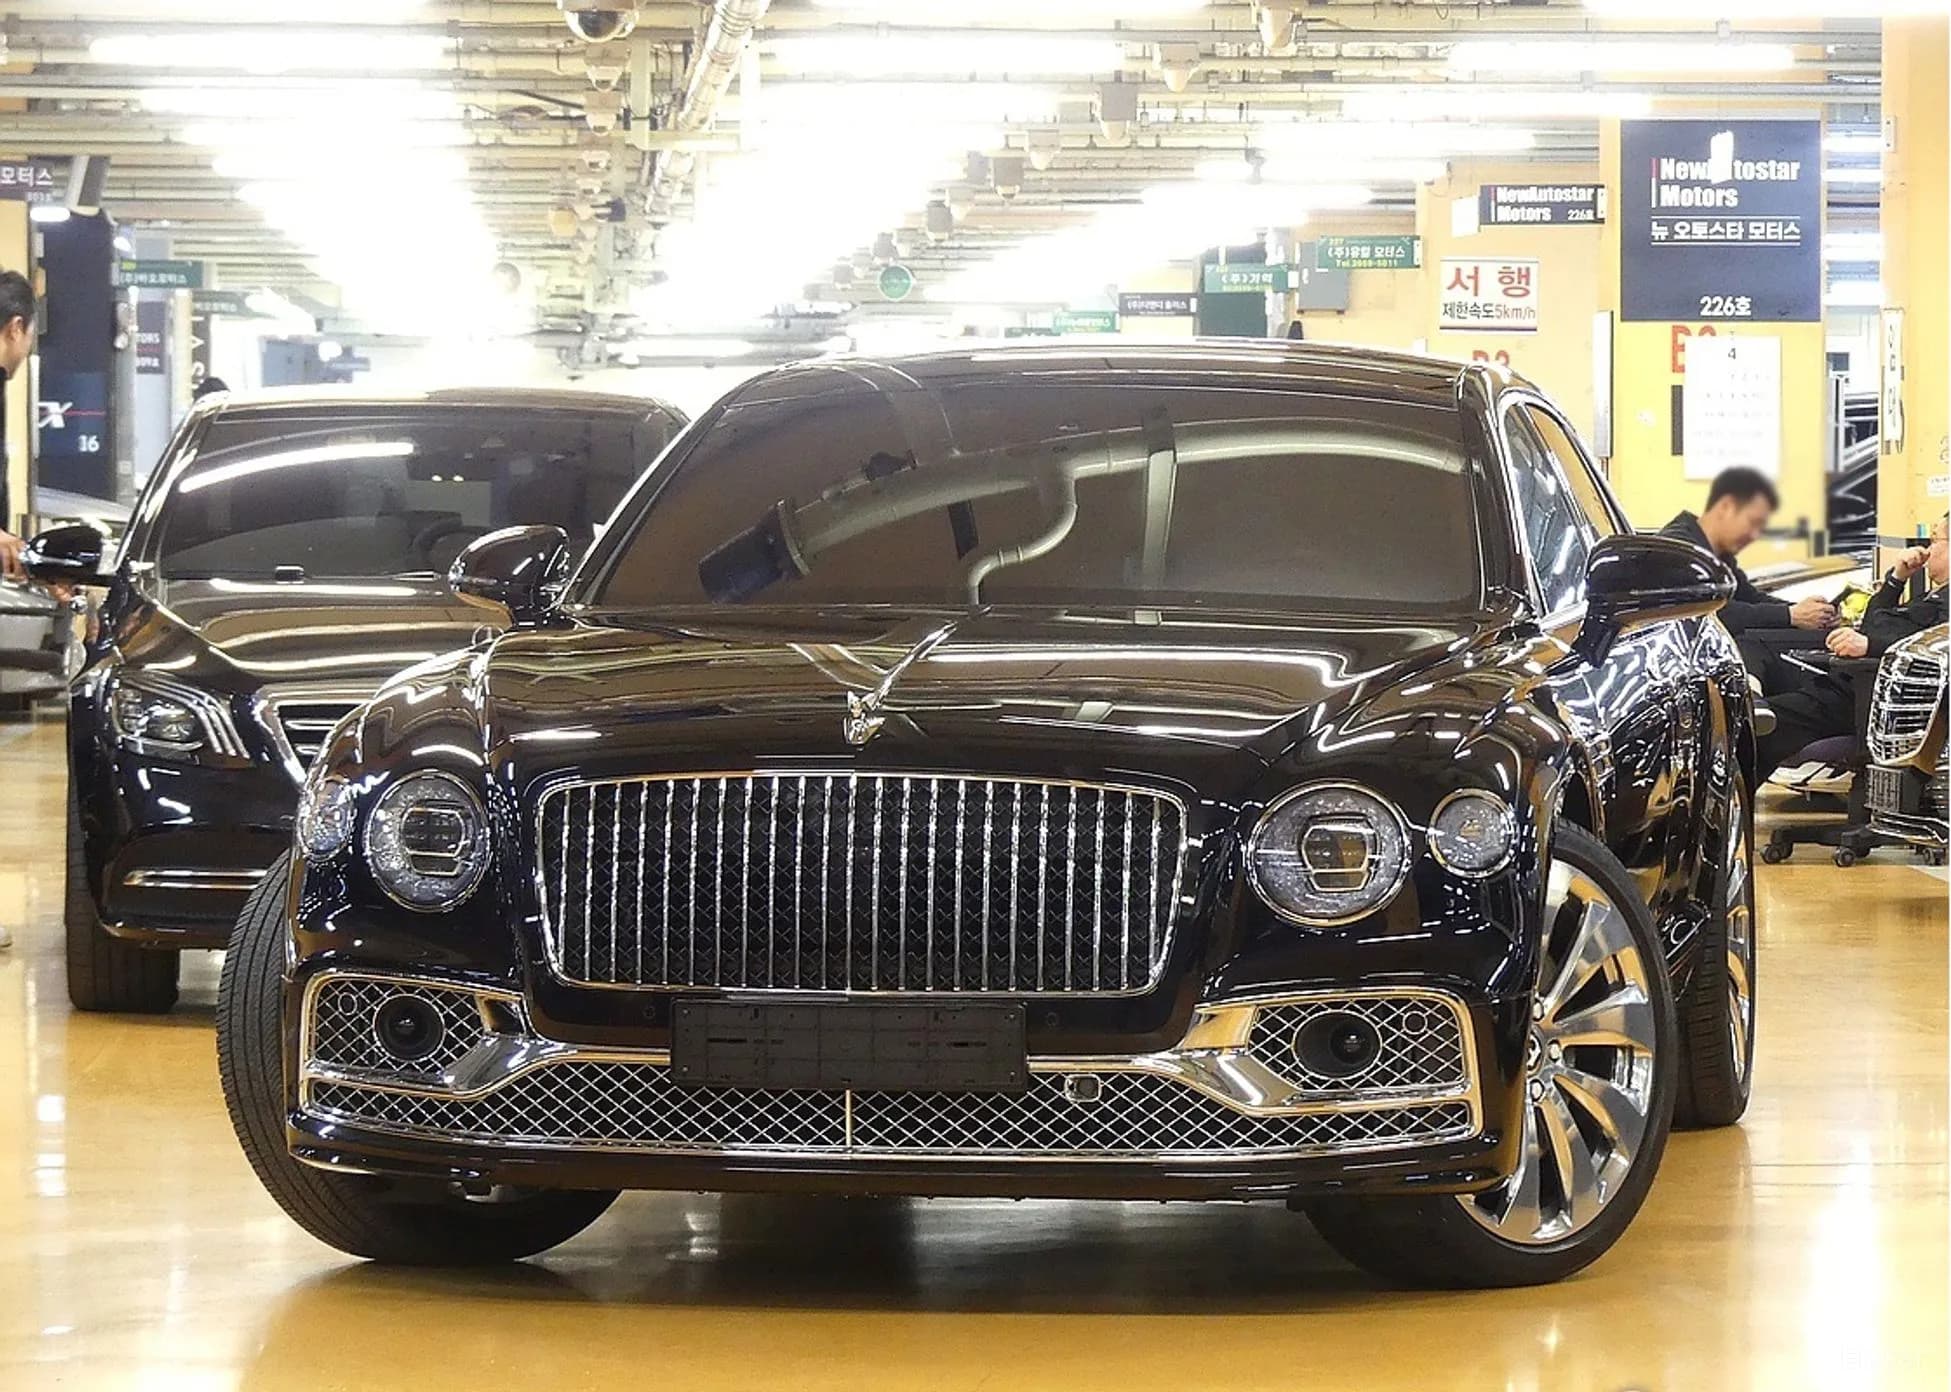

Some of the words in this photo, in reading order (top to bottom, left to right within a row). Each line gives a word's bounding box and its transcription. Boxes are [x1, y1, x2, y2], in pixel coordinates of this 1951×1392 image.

[0, 166, 54, 188] 모터스
[1660, 158, 1800, 181] Newtostar
[1496, 186, 1595, 203] NewAutostar
[1660, 185, 1740, 208] Motors
[1496, 205, 1552, 222] Motors
[1651, 221, 1669, 241] 뉴
[1673, 221, 1744, 241] 오토스타
[1748, 221, 1801, 241] 모터스
[1700, 295, 1752, 317] 226호
[78, 434, 100, 452] 16
